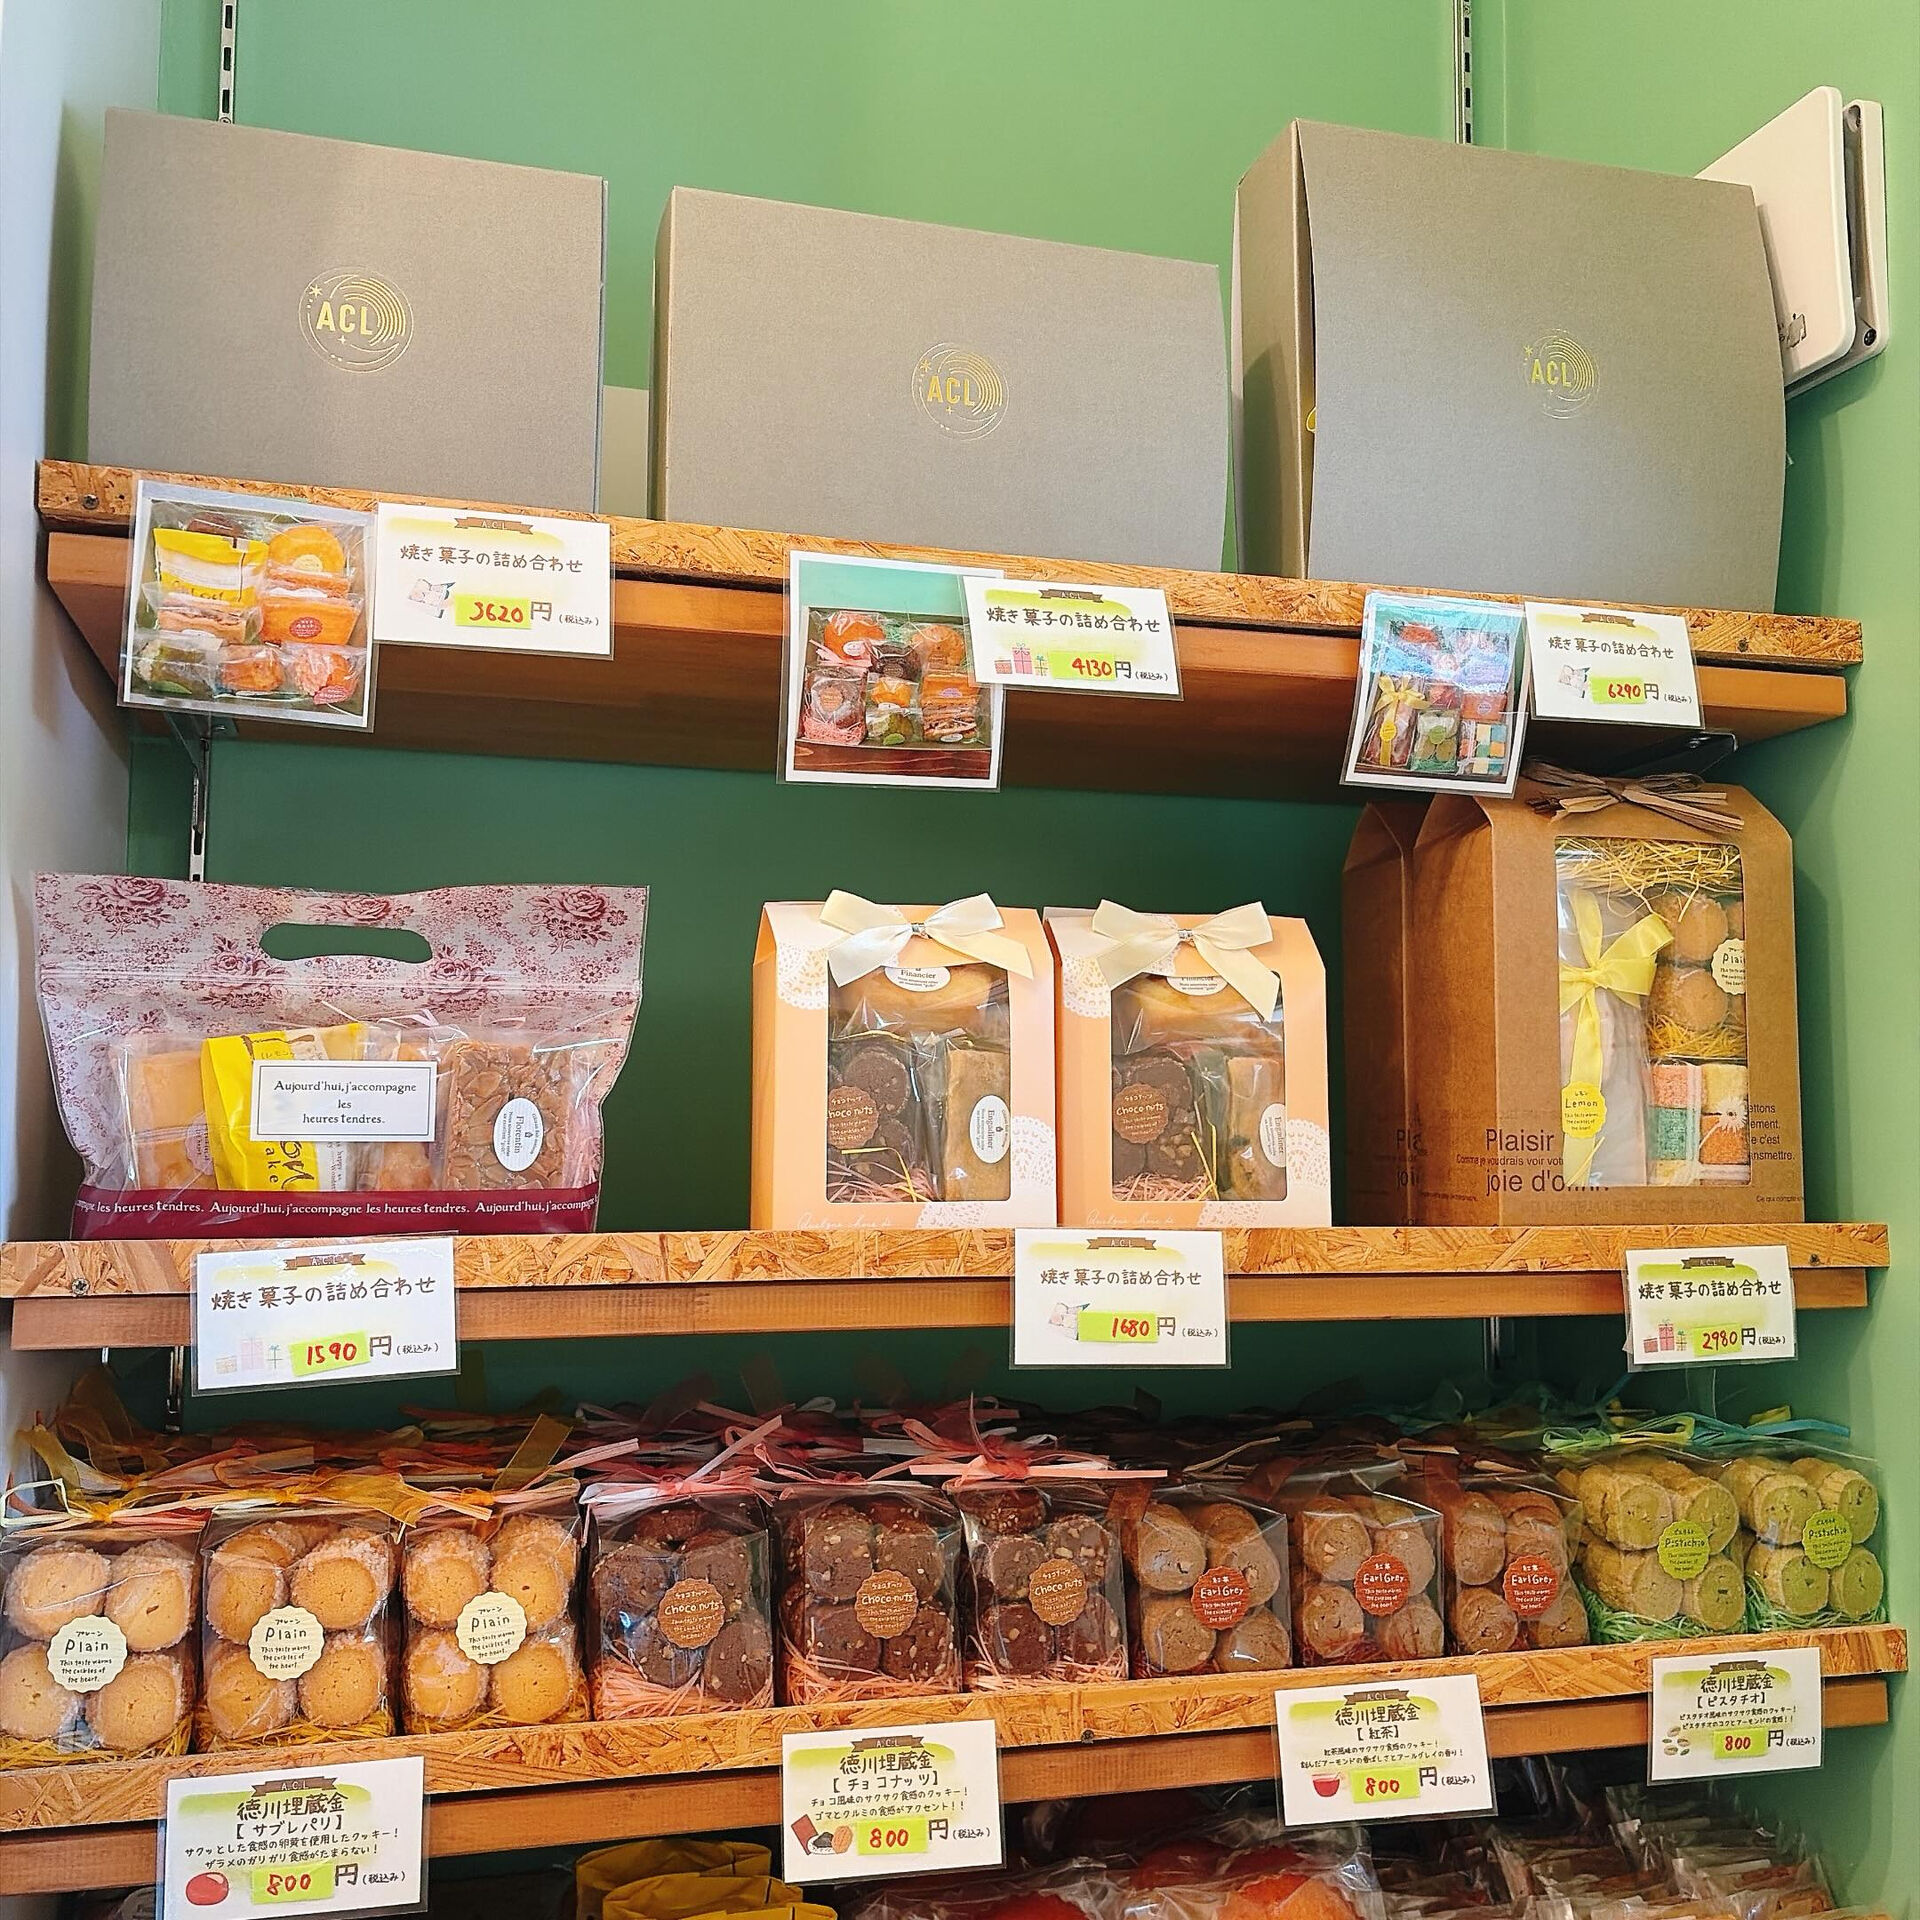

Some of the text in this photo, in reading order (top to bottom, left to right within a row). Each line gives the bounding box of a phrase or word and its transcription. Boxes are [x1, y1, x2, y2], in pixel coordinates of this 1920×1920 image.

[316, 300, 373, 335] ACL
[1531, 359, 1572, 387] ACL
[927, 375, 975, 408] ACL
[400, 544, 583, 573] 焼き菓子の詰め合わせ
[986, 607, 1160, 633] 焼き菓子の詰め合わせ
[1548, 637, 1674, 659] 焼き菓子の詰め合わせ
[1722, 953, 1745, 964] Plai
[901, 969, 937, 979] Financier
[338, 1100, 352, 1109] les
[828, 1106, 873, 1118] hoco nuts
[1145, 1102, 1164, 1111] nuts
[1565, 1098, 1598, 1109] Lemon
[1749, 1104, 1776, 1113] ettons
[303, 1113, 339, 1124] heures
[1751, 1120, 1780, 1129] ement.
[514, 1115, 524, 1154] Florentin
[986, 1110, 995, 1149] Engadiner
[1486, 1129, 1555, 1151] Plaisir
[1760, 1134, 1780, 1145] c'est
[265, 1147, 279, 1184] ake
[1487, 1156, 1524, 1166] voudrais
[1527, 1156, 1545, 1166] voir
[1547, 1156, 1564, 1166] vot
[1486, 1168, 1522, 1197] joie
[97, 1201, 111, 1212] les
[114, 1202, 154, 1213] heures
[366, 1203, 381, 1213] les
[384, 1203, 422, 1214] heures
[1040, 1268, 1202, 1286] 焼き菓子の詰め合わせ
[211, 1276, 436, 1311] 焼き菓子の詰め合わせ
[1638, 1279, 1781, 1300] 焼き菓子の詰め合わせ
[1064, 1578, 1083, 1588] nuts
[699, 1600, 719, 1610] nuts
[894, 1592, 913, 1602] nuts
[471, 1616, 510, 1632] Plain
[265, 1627, 306, 1642] Plain
[65, 1639, 108, 1655] Plain
[1700, 1673, 1775, 1693] 徳川埋蔵金
[1334, 1703, 1421, 1726] 徳川埋蔵金
[839, 1749, 935, 1775] 徳川埋蔵金
[236, 1791, 349, 1821] 徳川埋蔵金
